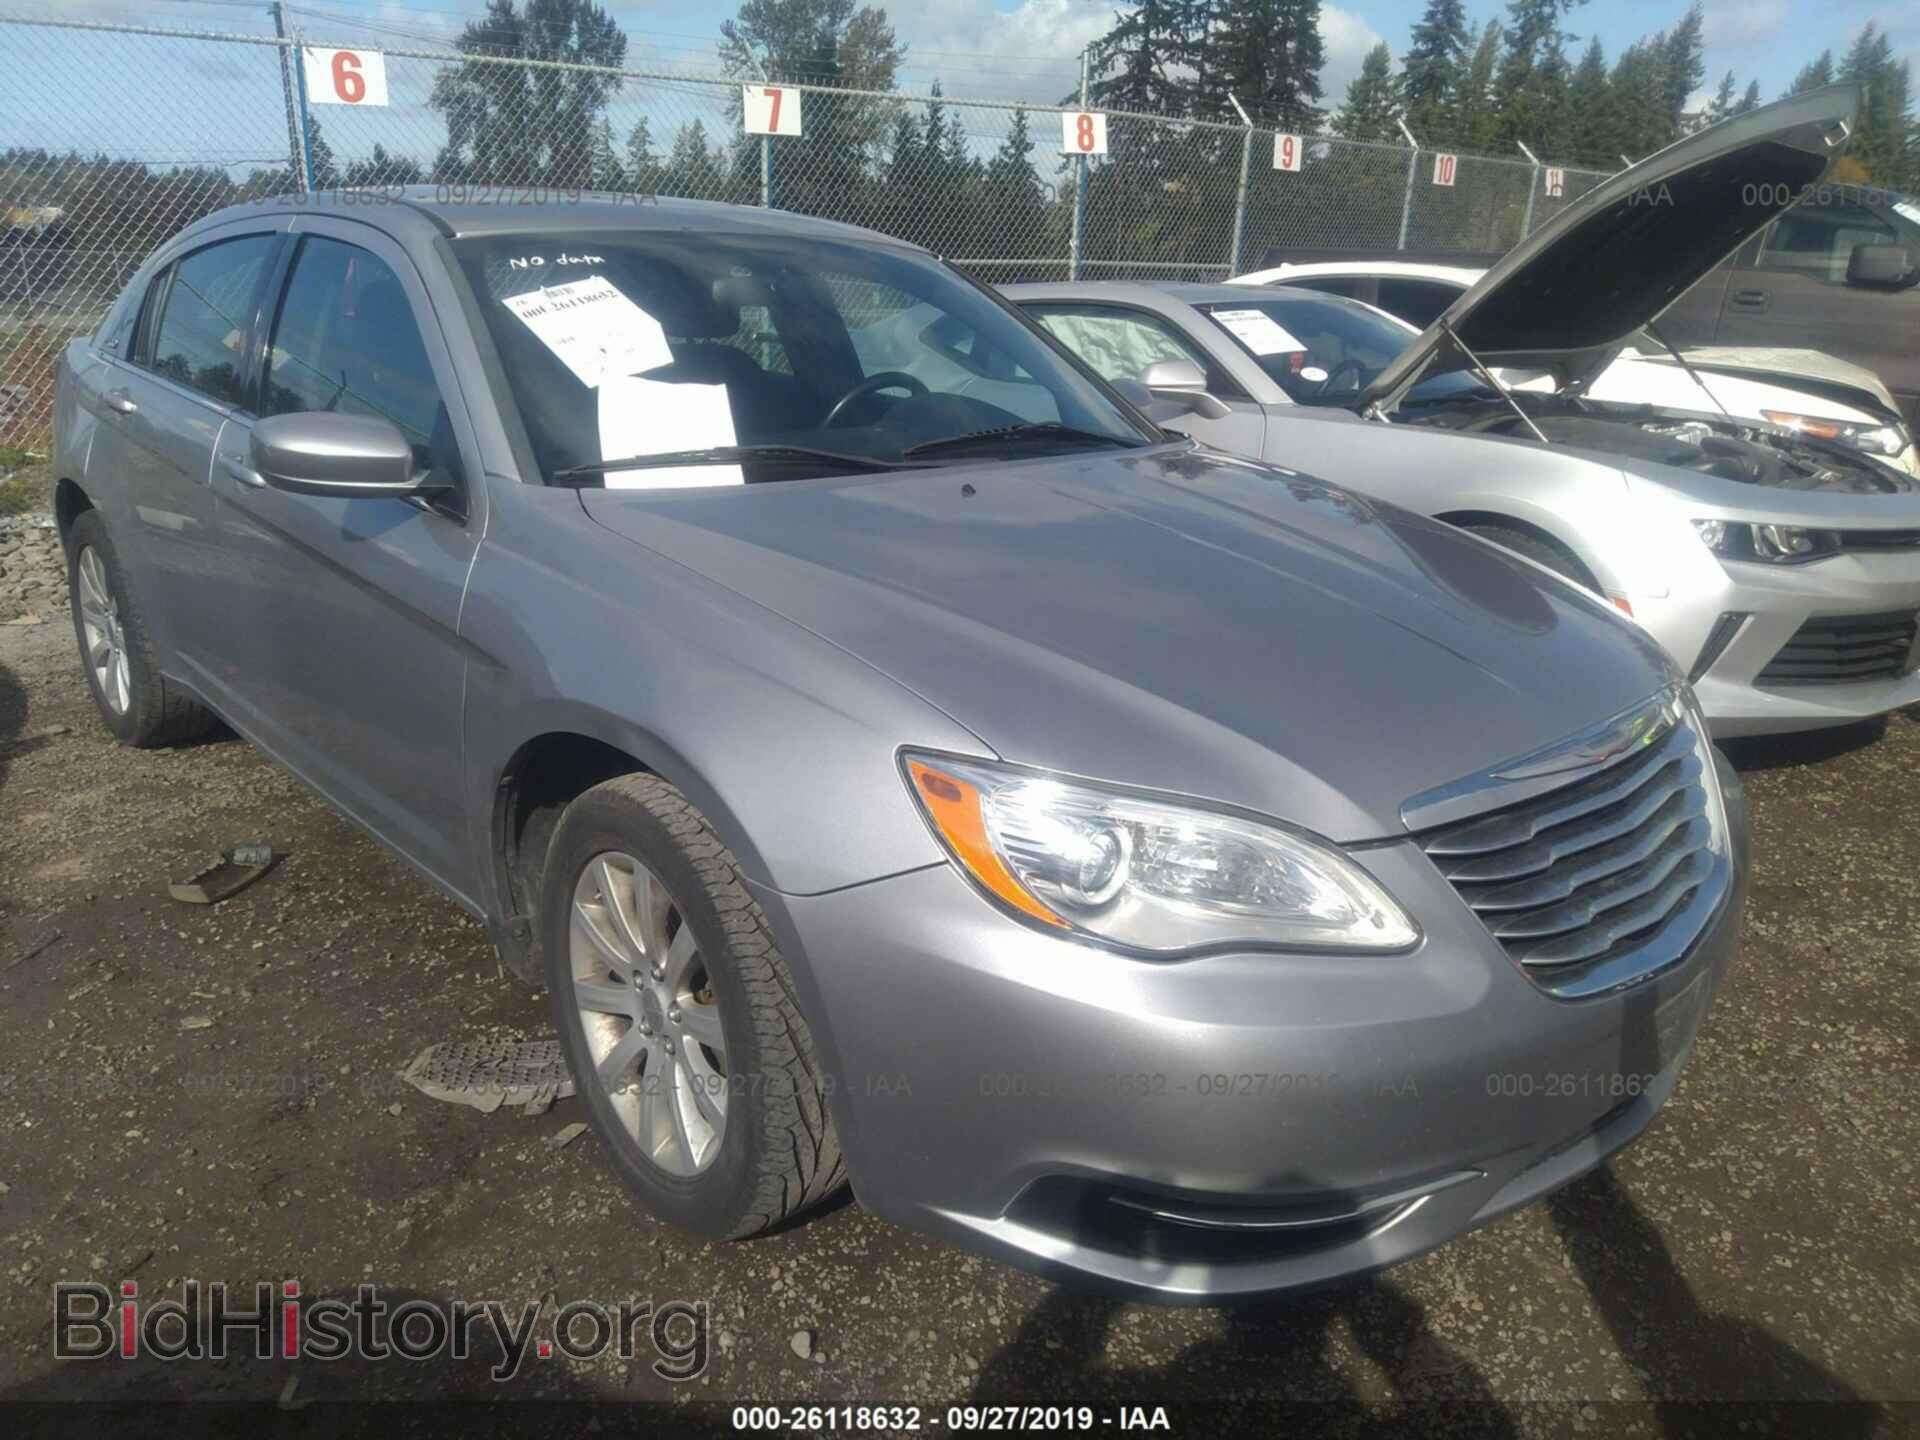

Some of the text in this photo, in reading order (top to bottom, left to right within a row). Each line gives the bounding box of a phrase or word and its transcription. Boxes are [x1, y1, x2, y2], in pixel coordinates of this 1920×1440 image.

[331, 52, 366, 102] 6
[763, 88, 783, 133] 7
[1076, 114, 1094, 152] 8
[1282, 136, 1293, 168] 9
[1439, 154, 1455, 184] 10
[555, 253, 605, 265] data
